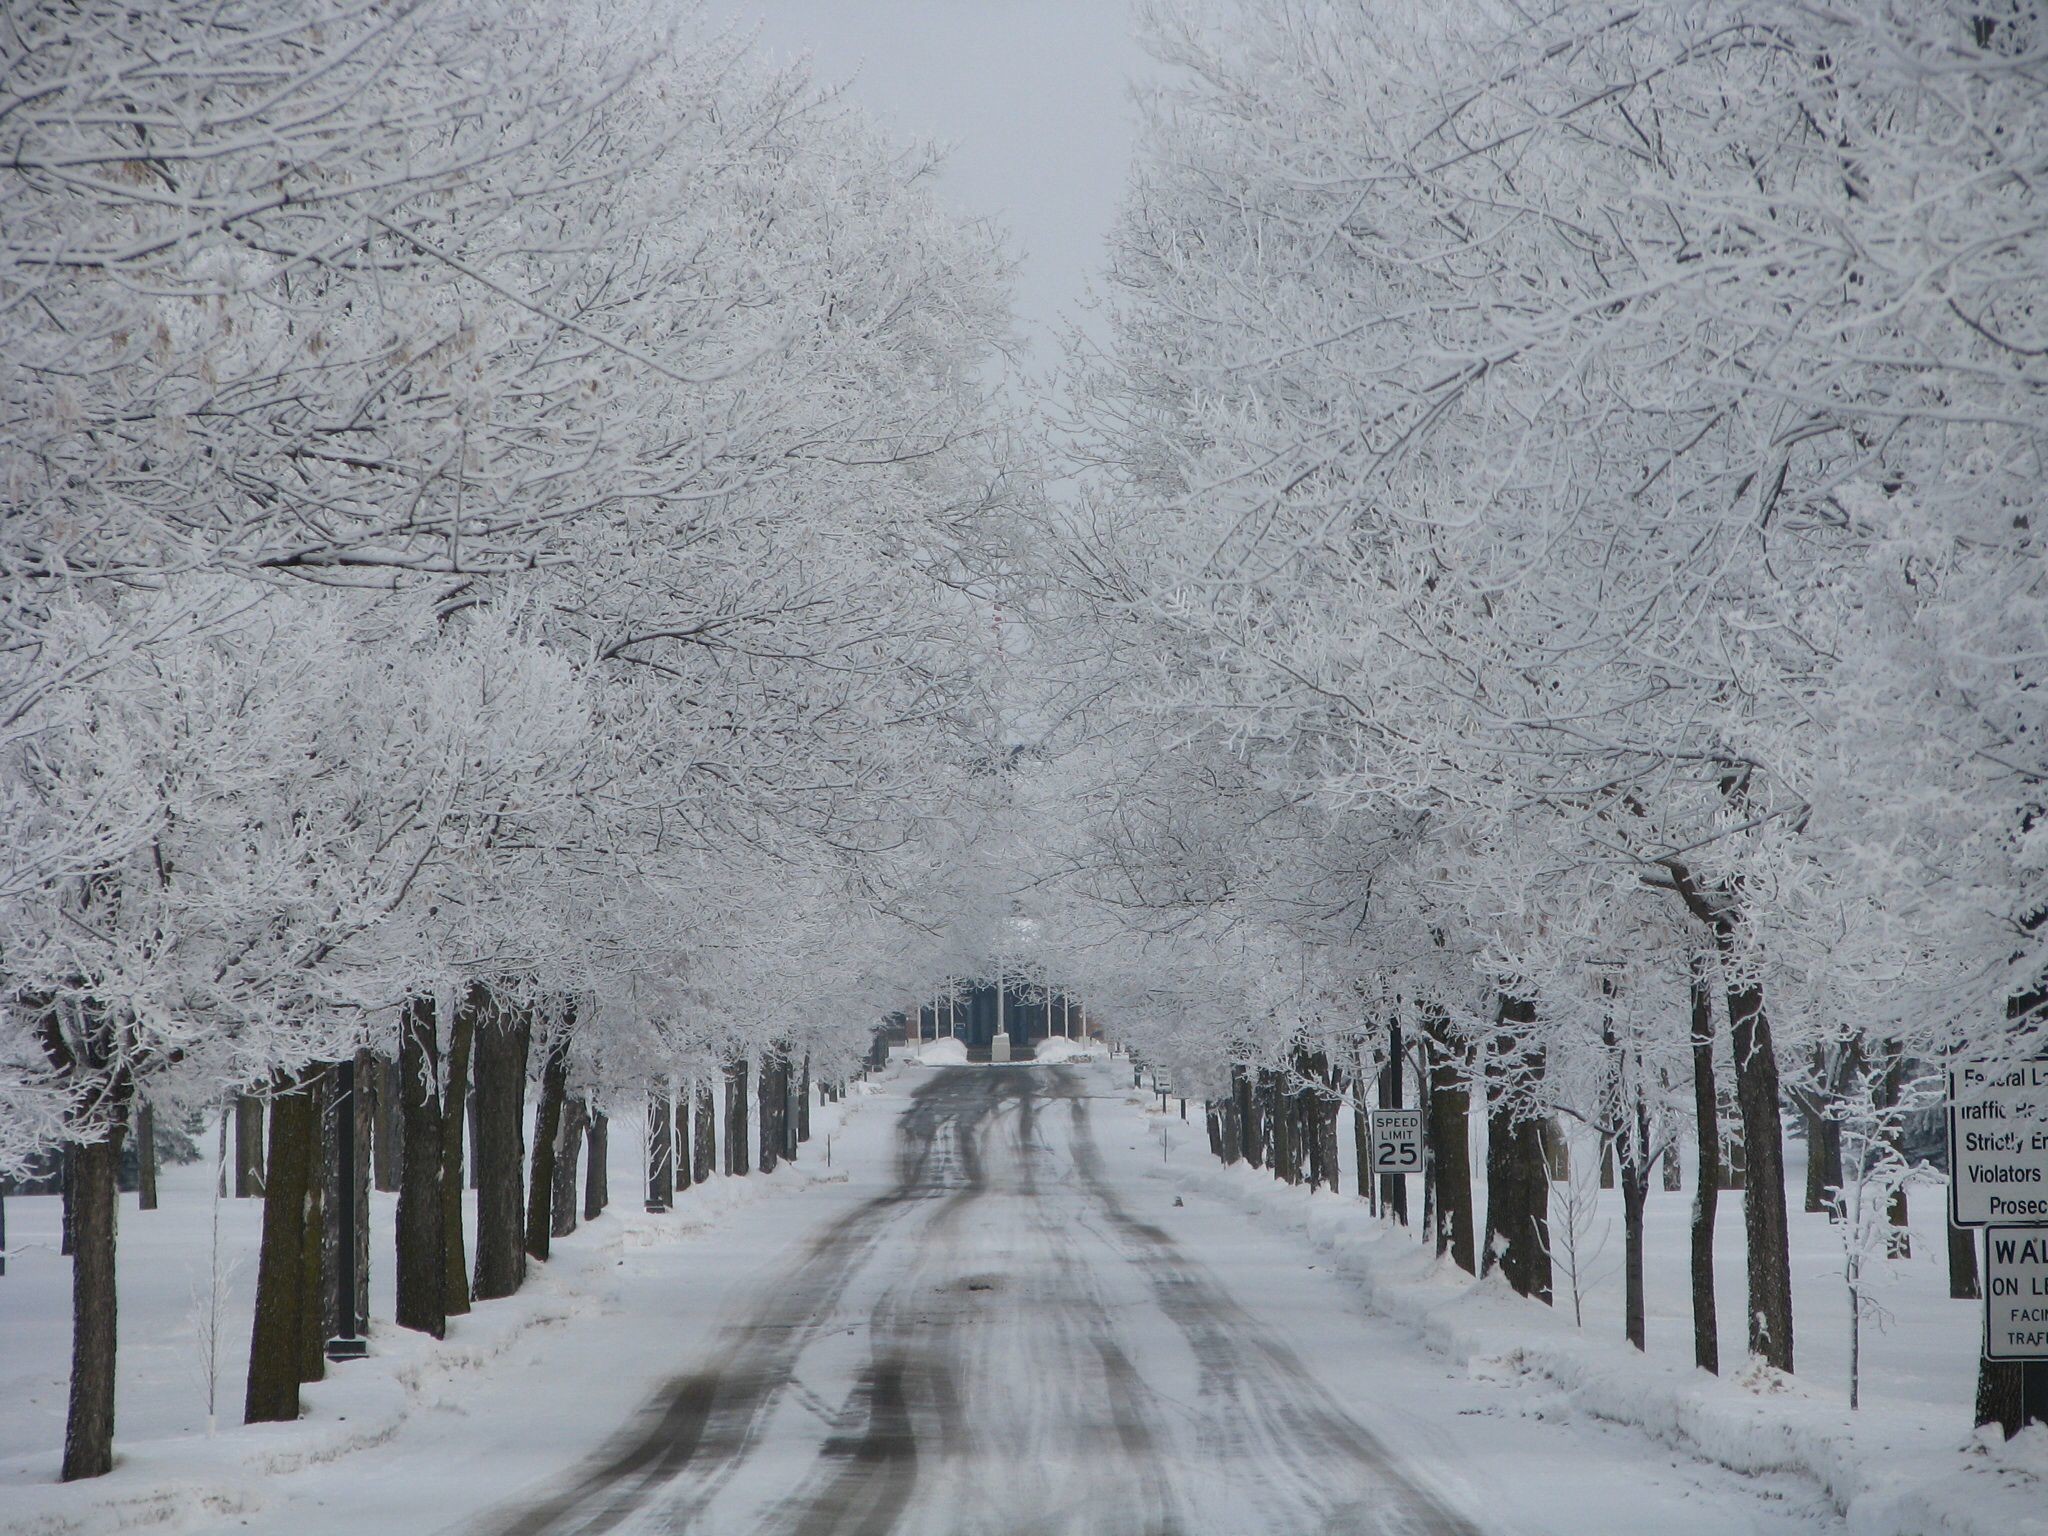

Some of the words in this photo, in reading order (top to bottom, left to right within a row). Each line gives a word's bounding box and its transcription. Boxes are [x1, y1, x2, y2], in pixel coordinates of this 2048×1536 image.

[1965, 1068, 2025, 1087] Feral
[1376, 1117, 1418, 1127] SPEED
[1381, 1130, 1413, 1140] LIMIT
[1966, 1132, 2023, 1153] Strictly
[1378, 1143, 1417, 1165] 25
[1968, 1165, 2041, 1183] Violators
[1990, 1196, 2048, 1214] Prosec
[1995, 1240, 2048, 1264] WAL
[1992, 1278, 2018, 1296] ON
[2008, 1332, 2048, 1345] TRAF
